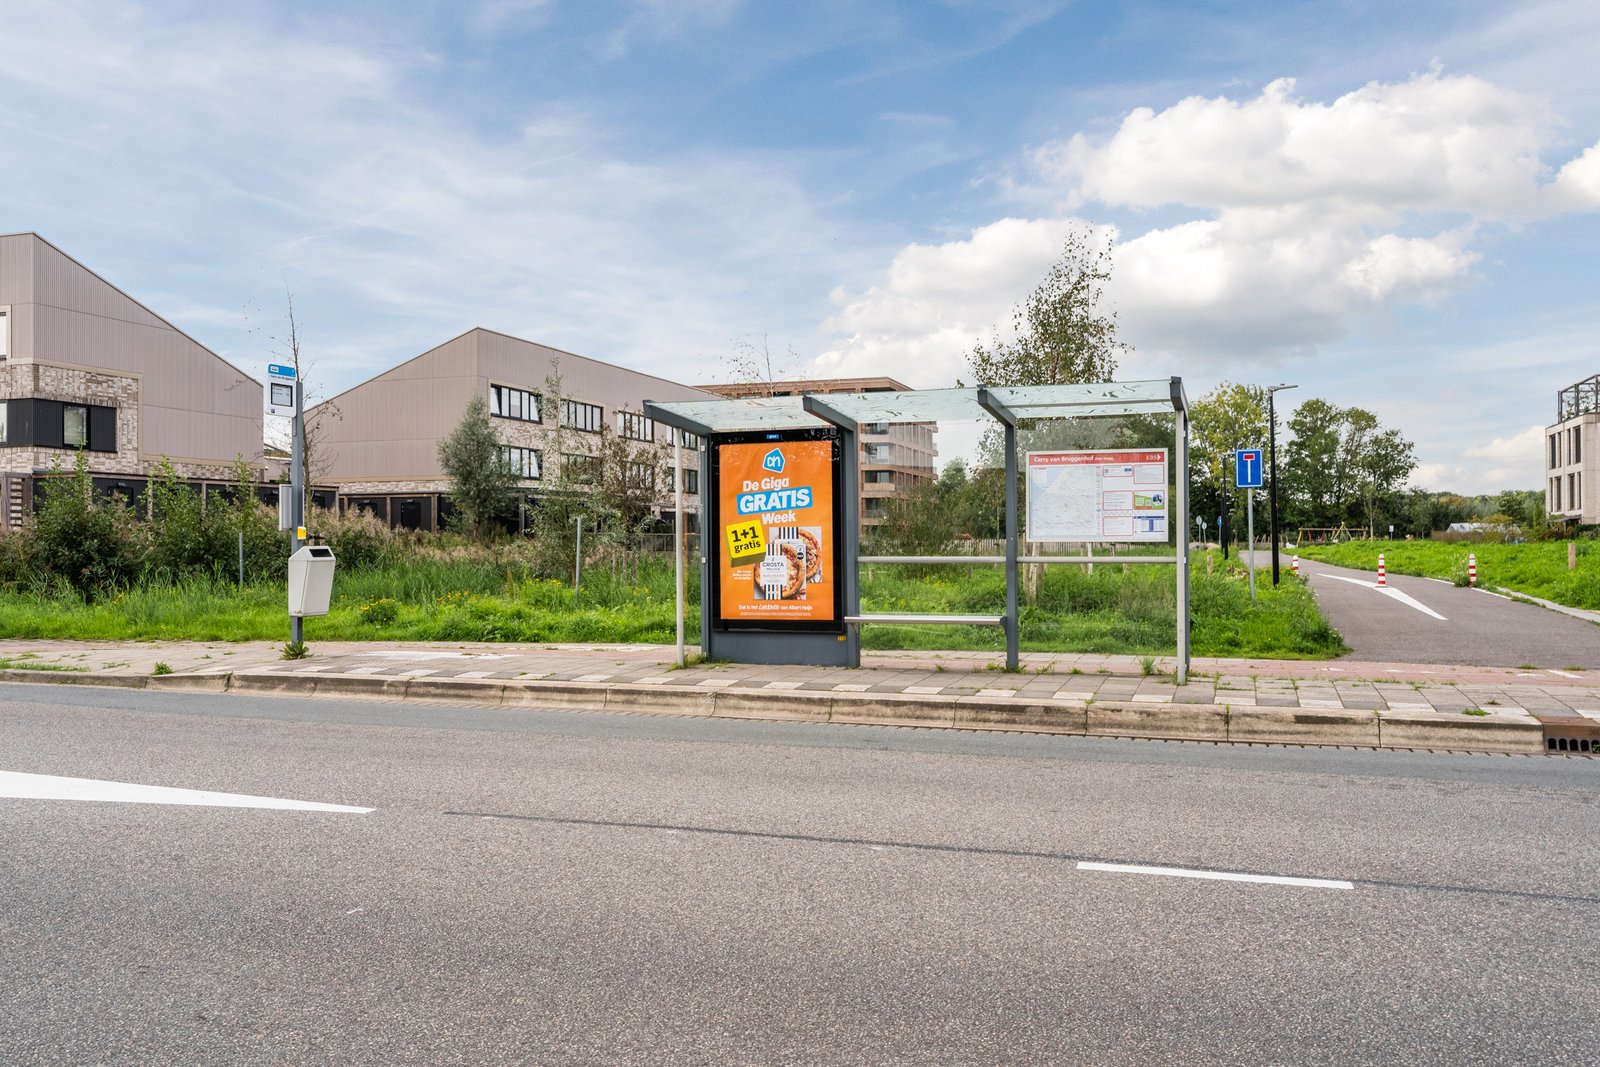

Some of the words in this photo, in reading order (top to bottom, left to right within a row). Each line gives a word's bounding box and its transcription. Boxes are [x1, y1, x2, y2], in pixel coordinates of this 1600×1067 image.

[742, 480, 759, 492] De
[761, 476, 790, 491] Giga
[740, 488, 810, 513] GRATIS
[762, 510, 796, 525] Week
[732, 526, 759, 542] 1+1
[734, 540, 761, 554] gratis
